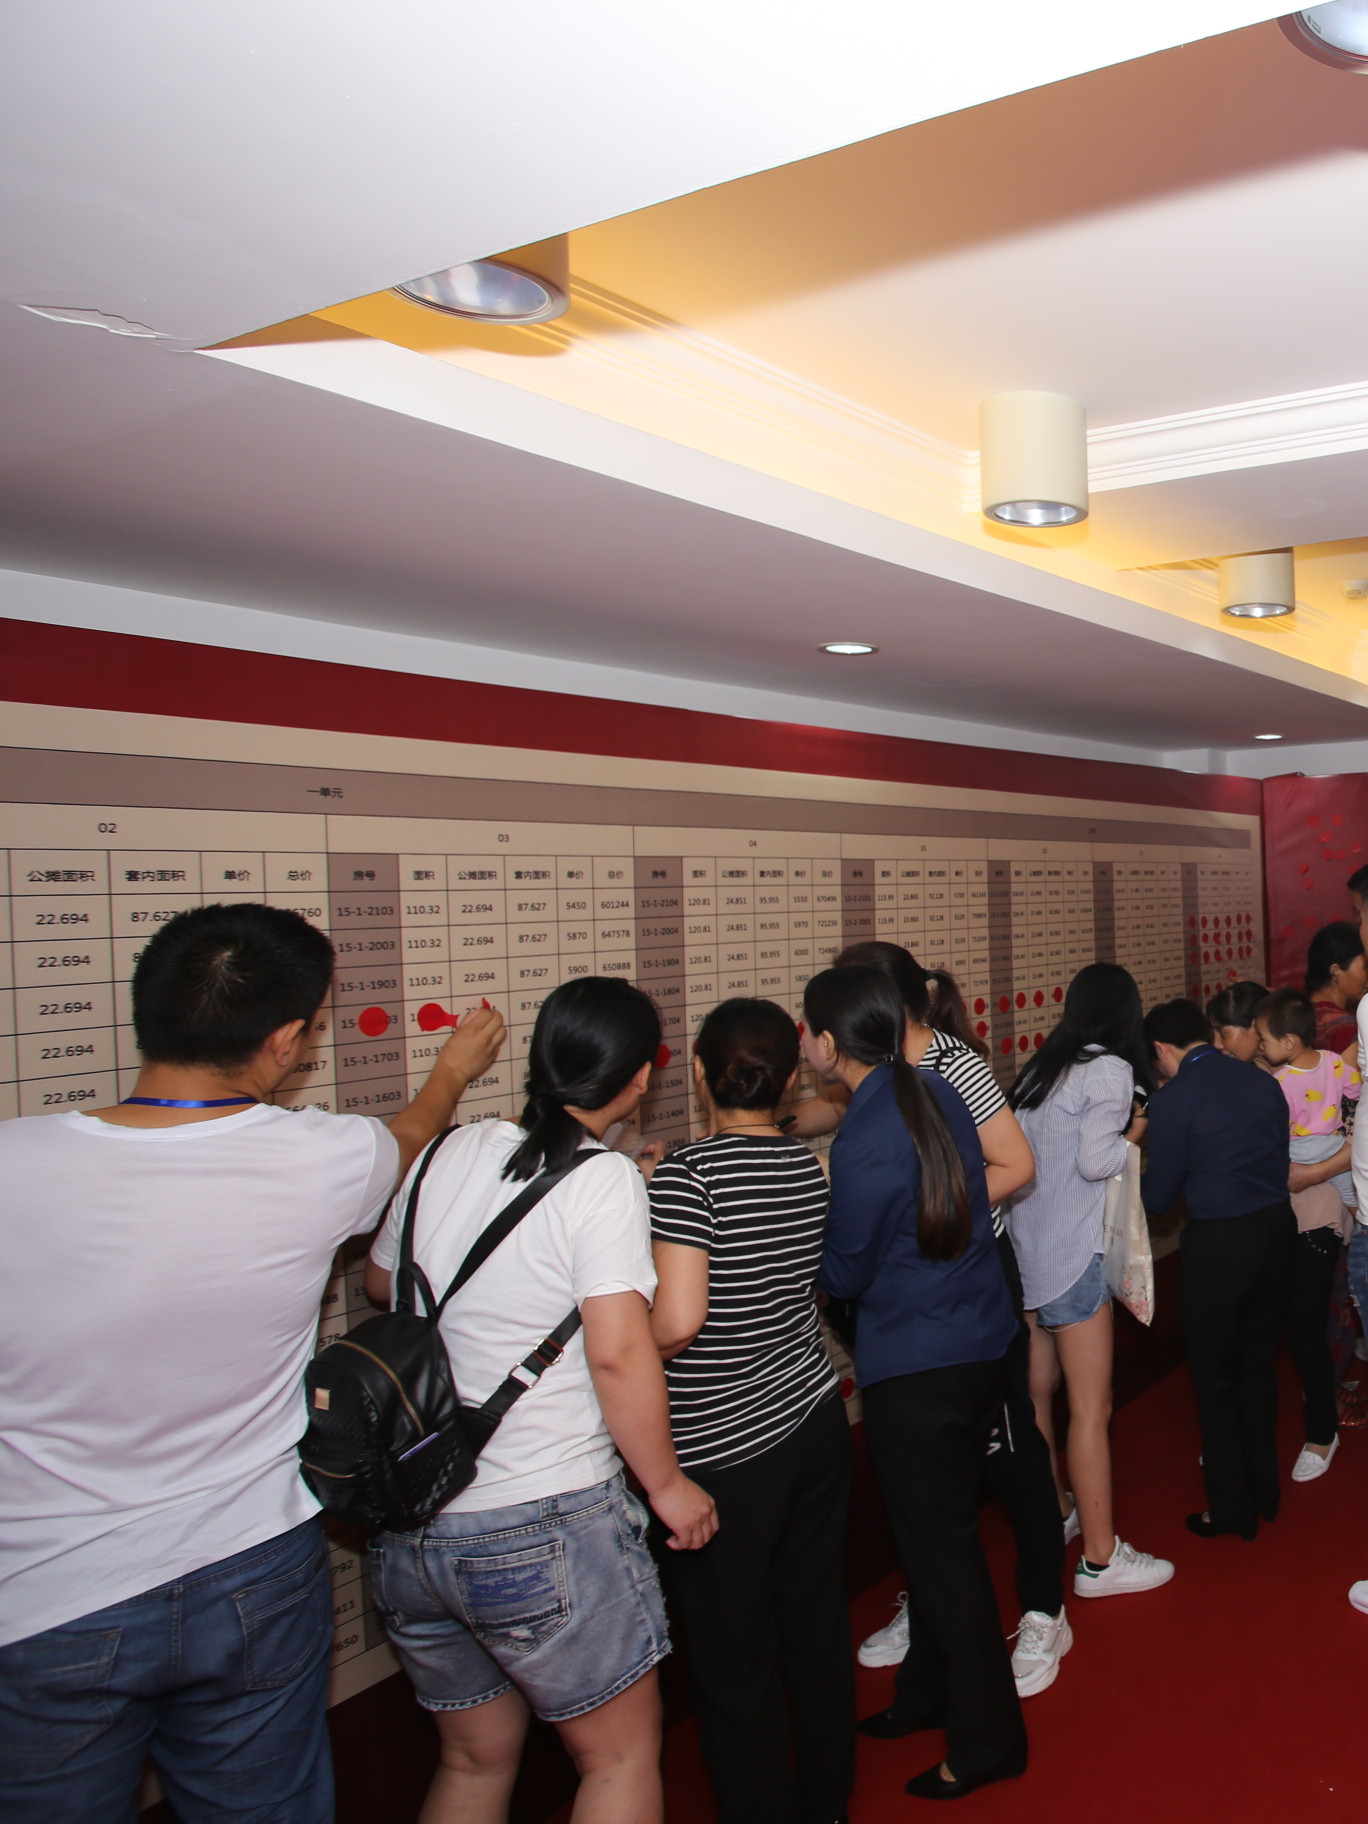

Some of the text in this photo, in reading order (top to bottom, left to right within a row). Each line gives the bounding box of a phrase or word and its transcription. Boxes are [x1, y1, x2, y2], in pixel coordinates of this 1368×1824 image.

[306, 786, 344, 799] 一单元
[98, 822, 118, 834] 02
[497, 833, 510, 843] 03
[26, 869, 96, 882] 公摊面积
[125, 869, 187, 882] 套内面积
[224, 869, 251, 882] 单价
[287, 869, 313, 881] 总价
[352, 870, 377, 882] 房号
[413, 870, 435, 881] 面积
[457, 870, 497, 881] 公摊面积
[514, 870, 552, 881] 套内面积
[566, 870, 584, 880] 单价
[607, 870, 624, 880] 总价
[35, 913, 89, 926] 22.694
[130, 910, 179, 923] 87.627
[337, 905, 395, 918] 15-1-2103
[405, 905, 441, 916] 110.32
[461, 903, 493, 914] 22.694
[517, 902, 547, 913] 87.627
[565, 901, 587, 911] 5450
[600, 900, 630, 910] 601244
[640, 898, 679, 908] 15-1-2104
[687, 897, 711, 907] 120.81
[725, 896, 747, 905] 24.851
[759, 896, 780, 905] 95.955
[37, 954, 91, 968] 22.694
[338, 940, 396, 953] 15-1-2003
[407, 938, 442, 950] 110.32
[462, 936, 494, 947] 22.694
[518, 933, 548, 944] 87.627
[566, 931, 588, 942] 5870
[601, 929, 631, 940] 647578
[641, 927, 679, 938] 15-1-2004
[688, 924, 711, 935] 120.81
[726, 922, 748, 932] 24.851
[759, 921, 780, 931] 95.955
[39, 1000, 93, 1016] 22.694
[339, 979, 397, 993] 15-1-1903
[408, 975, 444, 988] 110.32
[464, 972, 496, 984] 22.694
[519, 967, 549, 979] 87.627
[567, 964, 589, 975] 5900
[602, 961, 631, 973] 650888
[642, 957, 680, 969] 15-1-1904
[689, 954, 712, 965] 120.81
[727, 952, 748, 962] 24.851
[760, 950, 780, 960] 95.955
[41, 1044, 95, 1060] 22.694
[689, 983, 713, 994] 120.81
[727, 979, 749, 990] 24.851
[760, 976, 781, 986] 95.955
[43, 1088, 97, 1106] 22.694
[343, 1052, 400, 1068] 15-1-1703
[411, 1046, 442, 1059] 110.3
[344, 1090, 402, 1109] 15-1-1603
